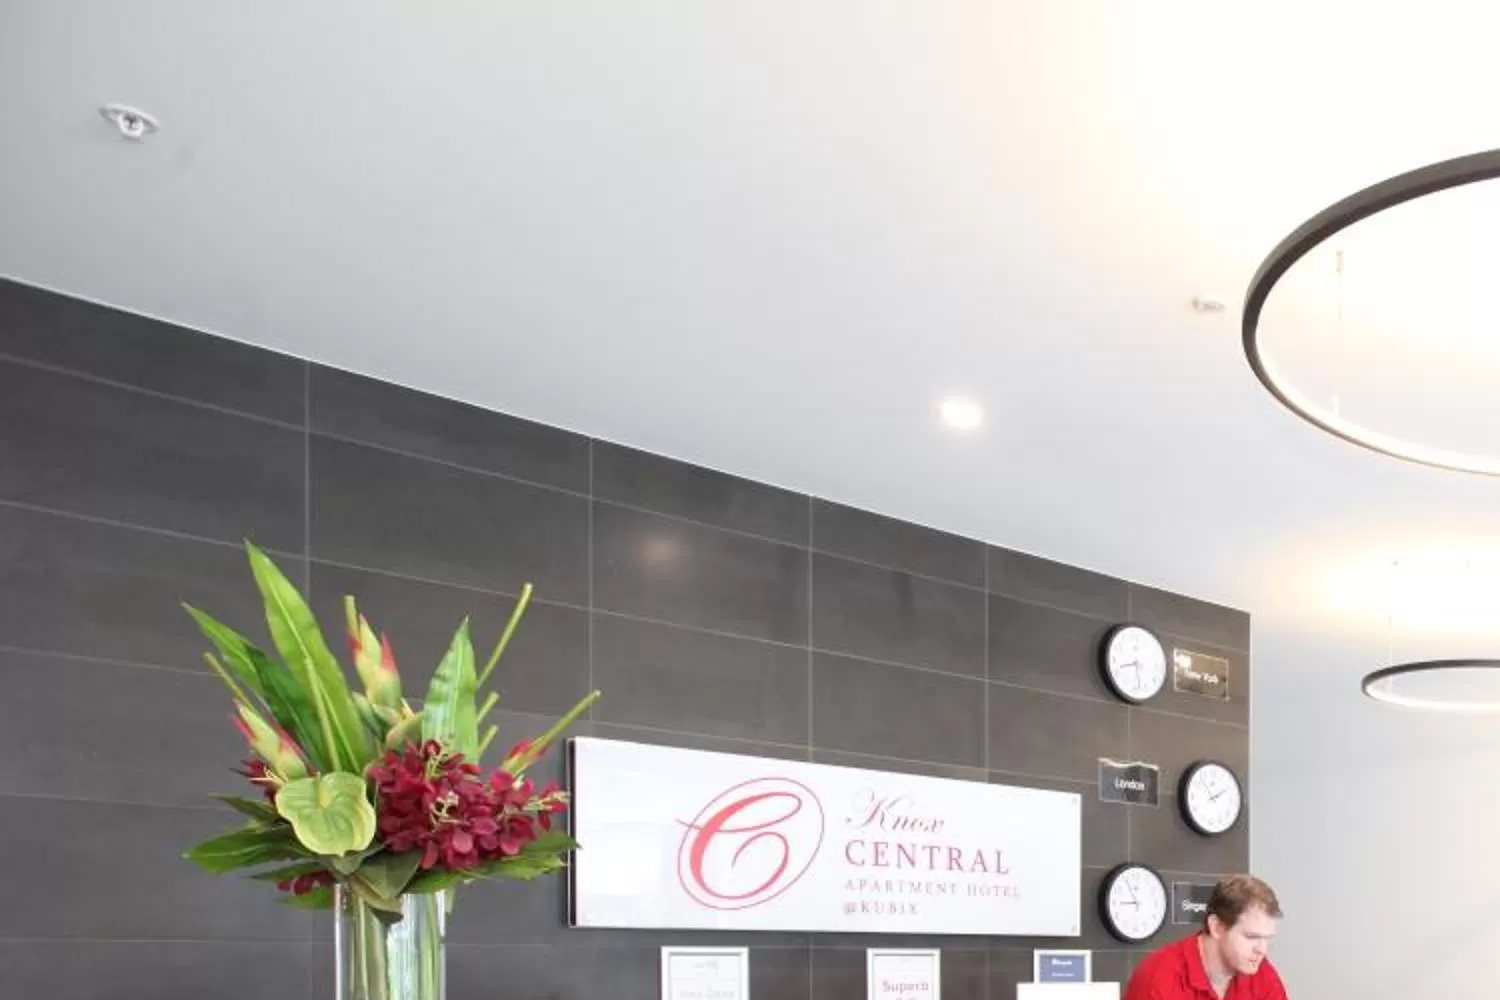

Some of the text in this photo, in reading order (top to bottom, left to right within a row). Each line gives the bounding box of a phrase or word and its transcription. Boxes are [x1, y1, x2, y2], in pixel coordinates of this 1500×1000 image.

[1114, 776, 1145, 791] London
[845, 788, 945, 833] Knox
[844, 839, 1009, 875] CENTRAL
[844, 879, 1021, 899] APARTMENT HOTEL
[881, 980, 929, 994] Superb
